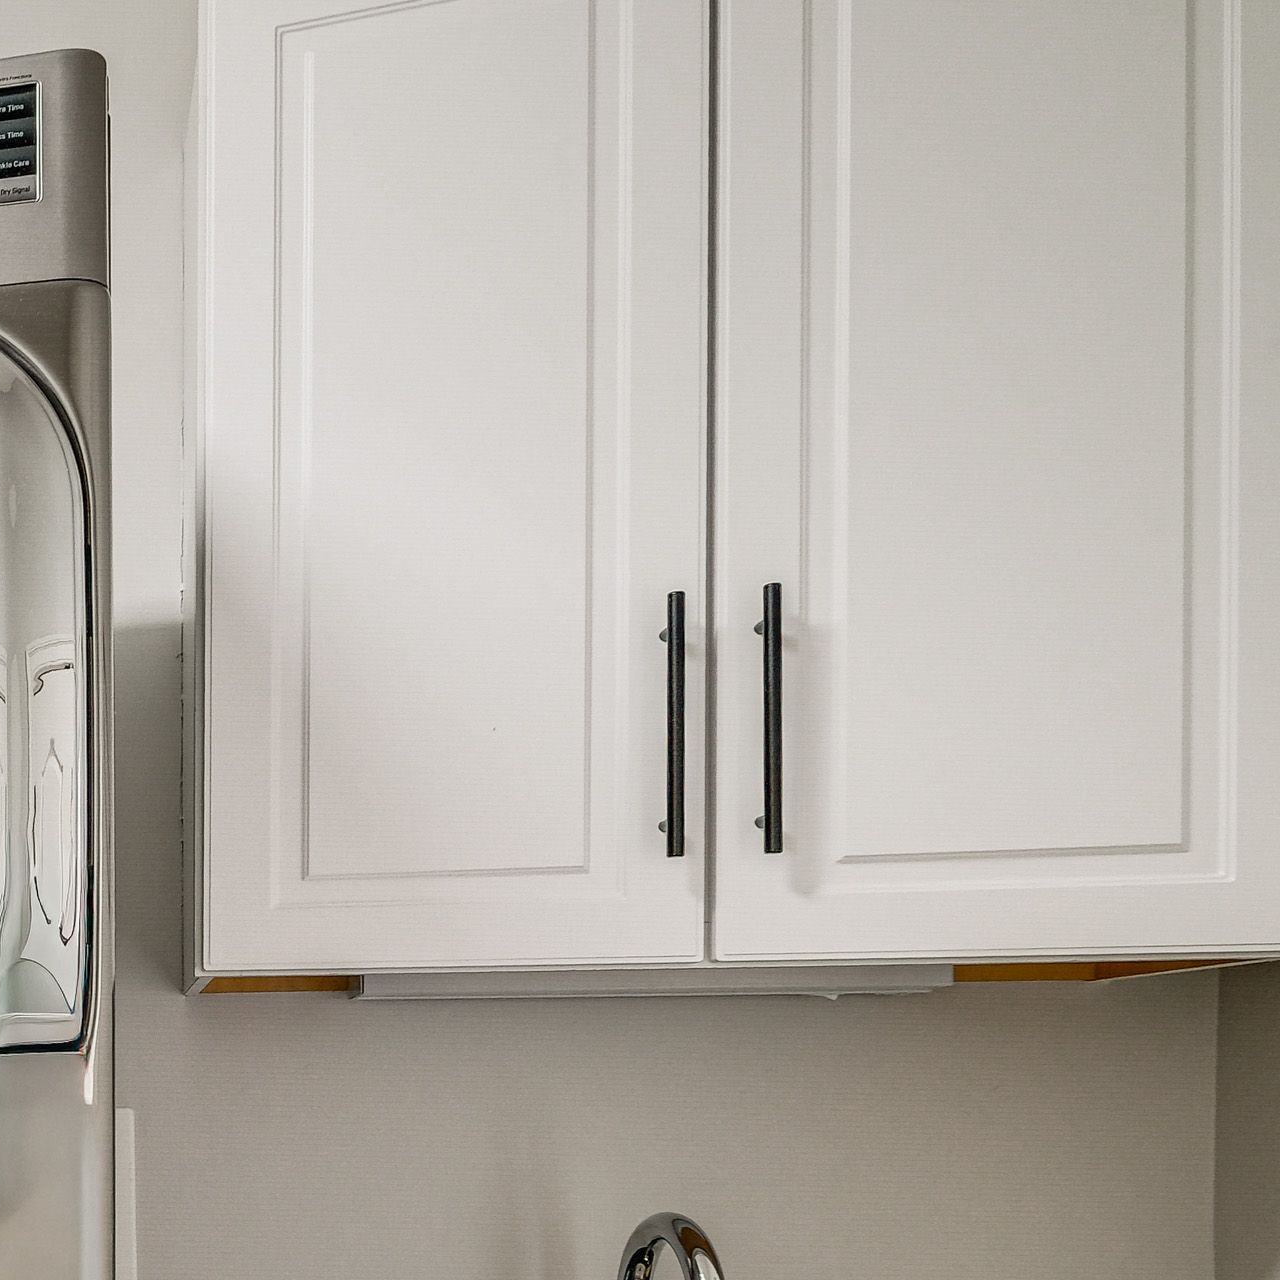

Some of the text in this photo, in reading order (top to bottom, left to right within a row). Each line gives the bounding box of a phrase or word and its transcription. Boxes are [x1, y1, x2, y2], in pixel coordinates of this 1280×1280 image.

[8, 104, 24, 112] Time
[7, 130, 24, 138] Time
[13, 159, 30, 168] Care
[0, 188, 11, 196] Dry
[12, 186, 31, 194] Signal
